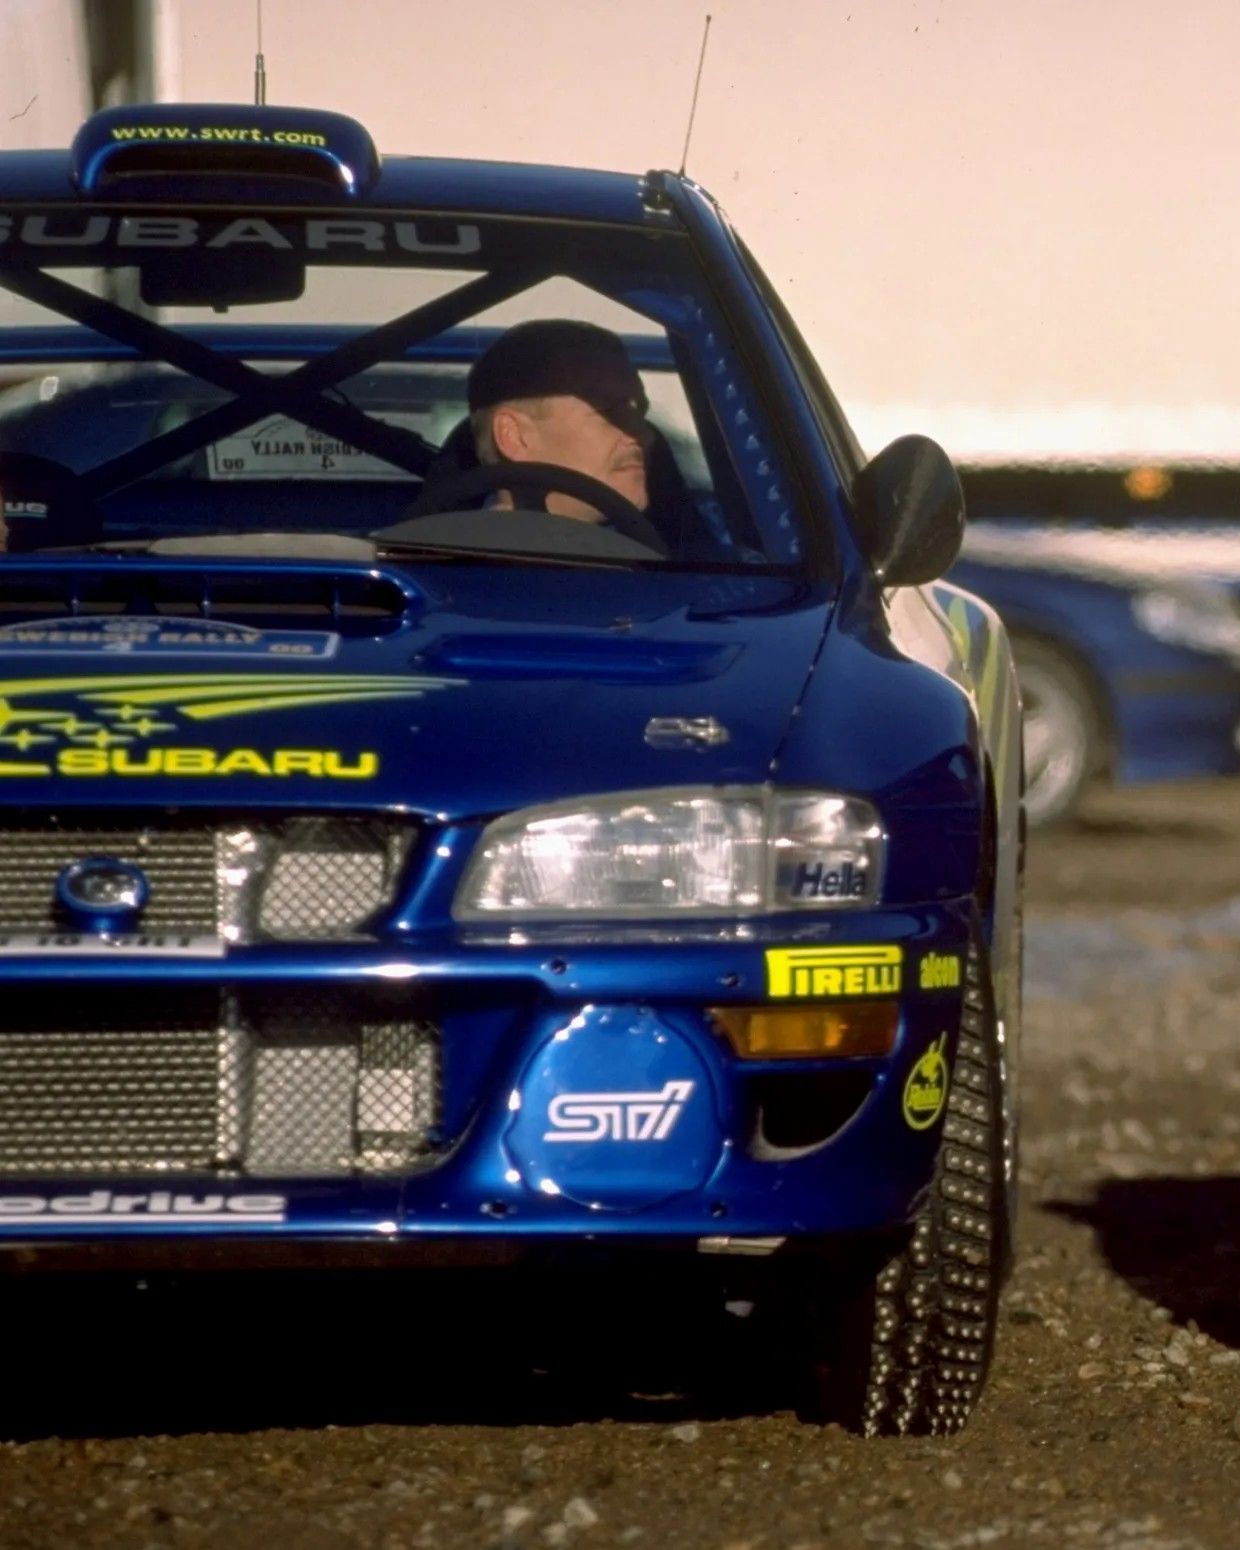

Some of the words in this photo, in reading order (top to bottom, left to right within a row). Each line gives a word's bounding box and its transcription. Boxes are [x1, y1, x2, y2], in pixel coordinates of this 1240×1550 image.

[112, 125, 327, 147] www.swrt.com
[0, 214, 482, 255] UBARU
[57, 749, 379, 778] SUBARU
[793, 862, 866, 896] Hella
[765, 945, 903, 997] PIRELLI
